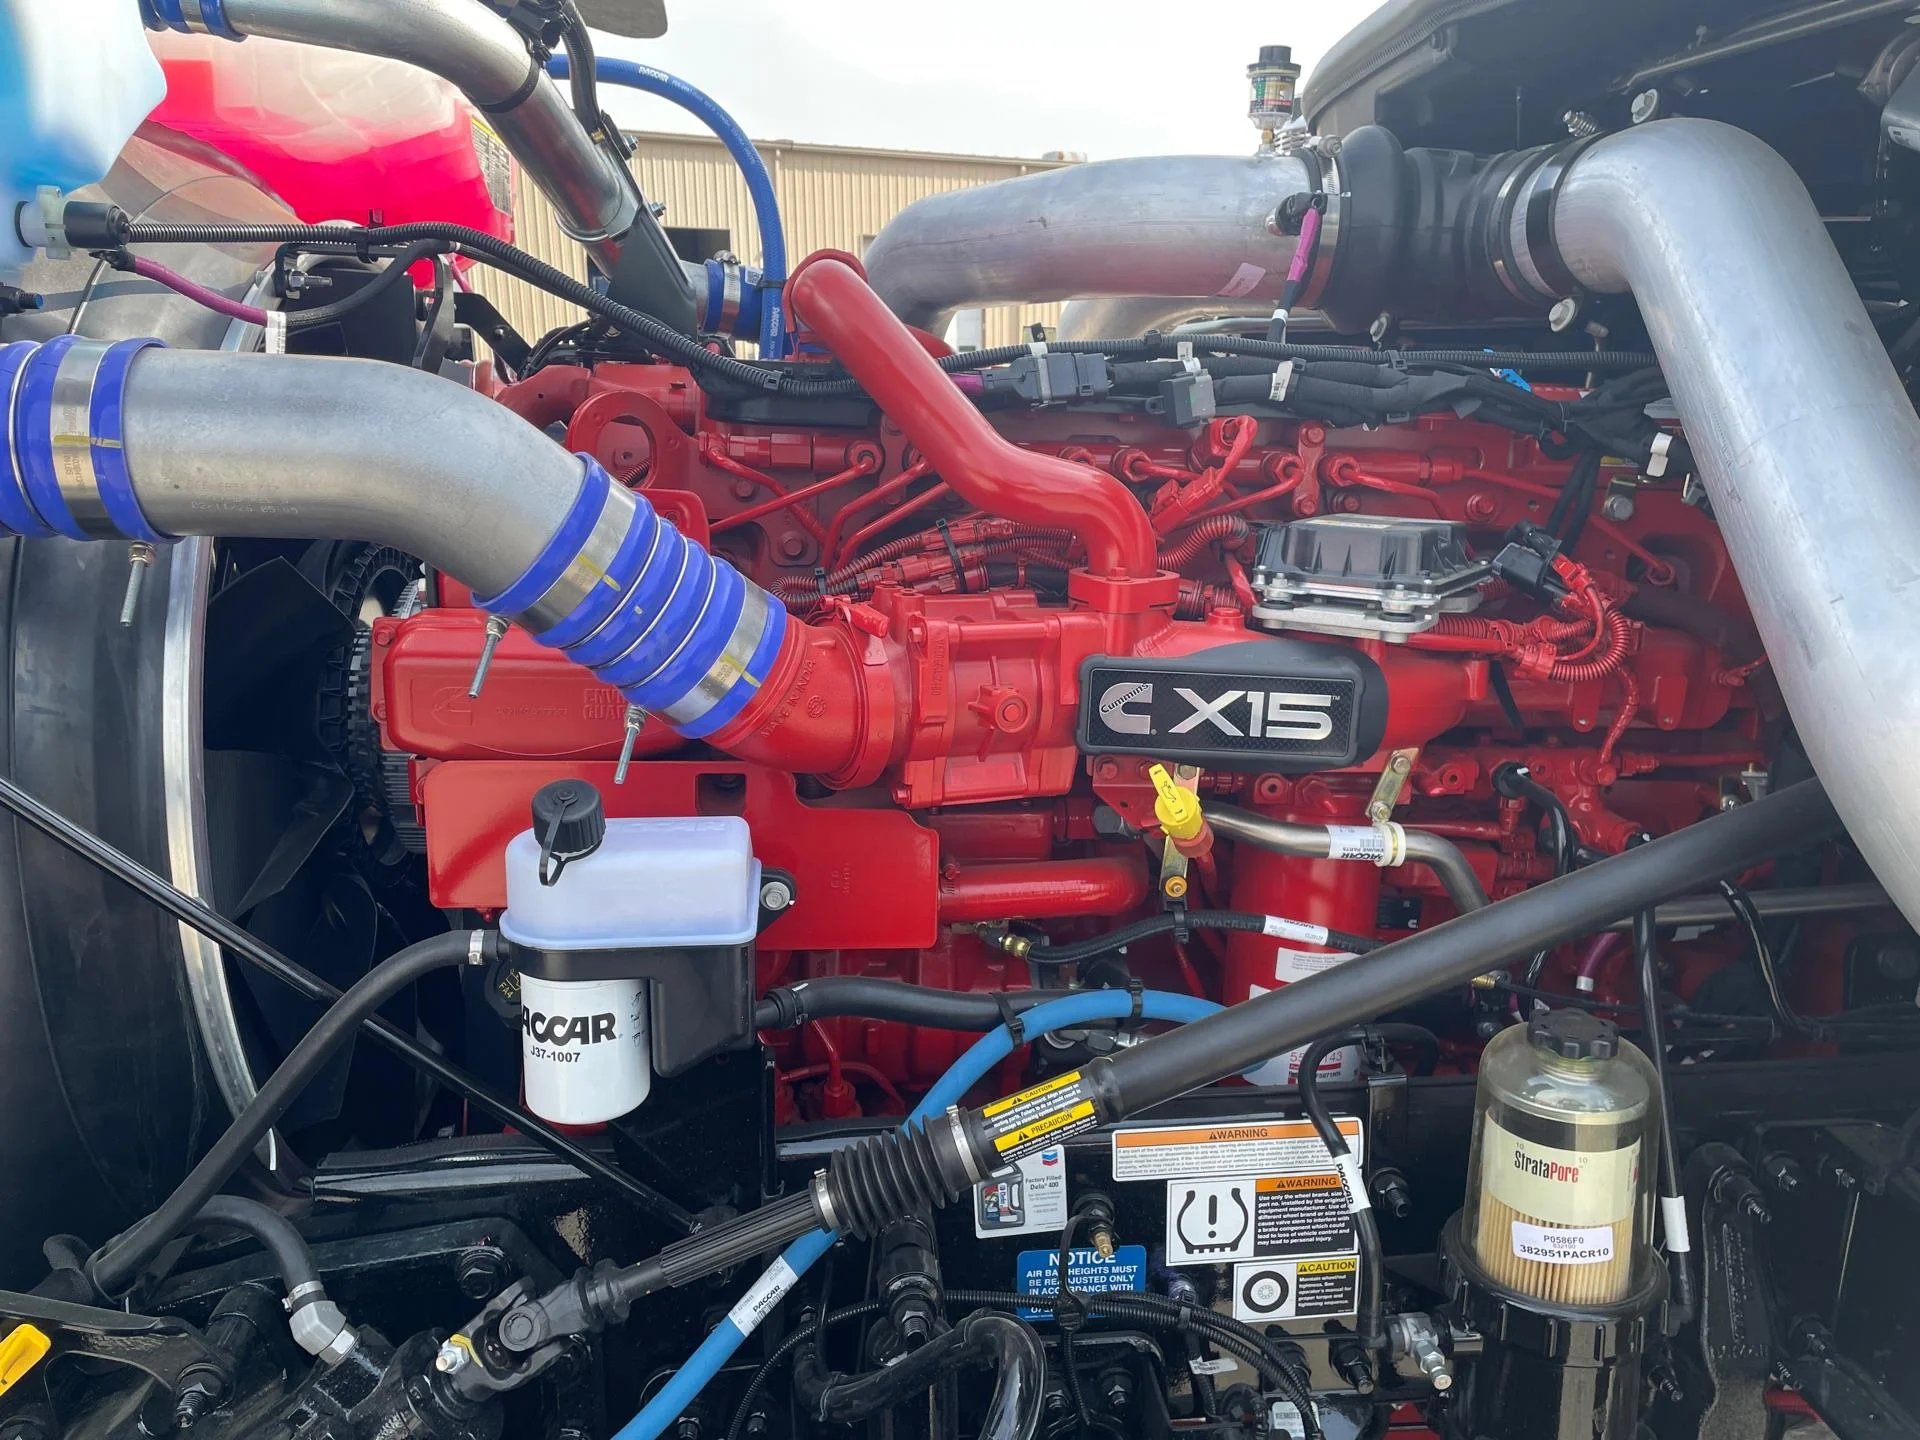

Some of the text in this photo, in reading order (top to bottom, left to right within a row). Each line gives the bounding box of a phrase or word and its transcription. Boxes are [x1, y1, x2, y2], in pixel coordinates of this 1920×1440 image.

[1100, 683, 1149, 713] Cummins
[1168, 688, 1332, 740] X15
[1193, 919, 1262, 930] DYNACRAFT
[522, 1004, 617, 1046] ACCAR
[530, 1046, 580, 1062] J37-1007
[1025, 1084, 1052, 1097] CAUTION
[1217, 1128, 1268, 1139] WARNING
[1514, 1150, 1579, 1183] StrataPore
[1285, 1178, 1336, 1188] WARNING
[1336, 1163, 1354, 1204] PACCAR
[1258, 1207, 1288, 1215] equipment
[1543, 1234, 1584, 1245] P0586F0
[1520, 1244, 1609, 1259] 382951PACR10
[1026, 1265, 1138, 1278] AIR BA HEIGHTS MUST
[1307, 1261, 1355, 1272] CAUTION
[1029, 1275, 1135, 1287] BE REJUSTED ONLY
[1029, 1283, 1134, 1296] IN ACCRDANCE WITH
[752, 1285, 781, 1312] PACCAR
